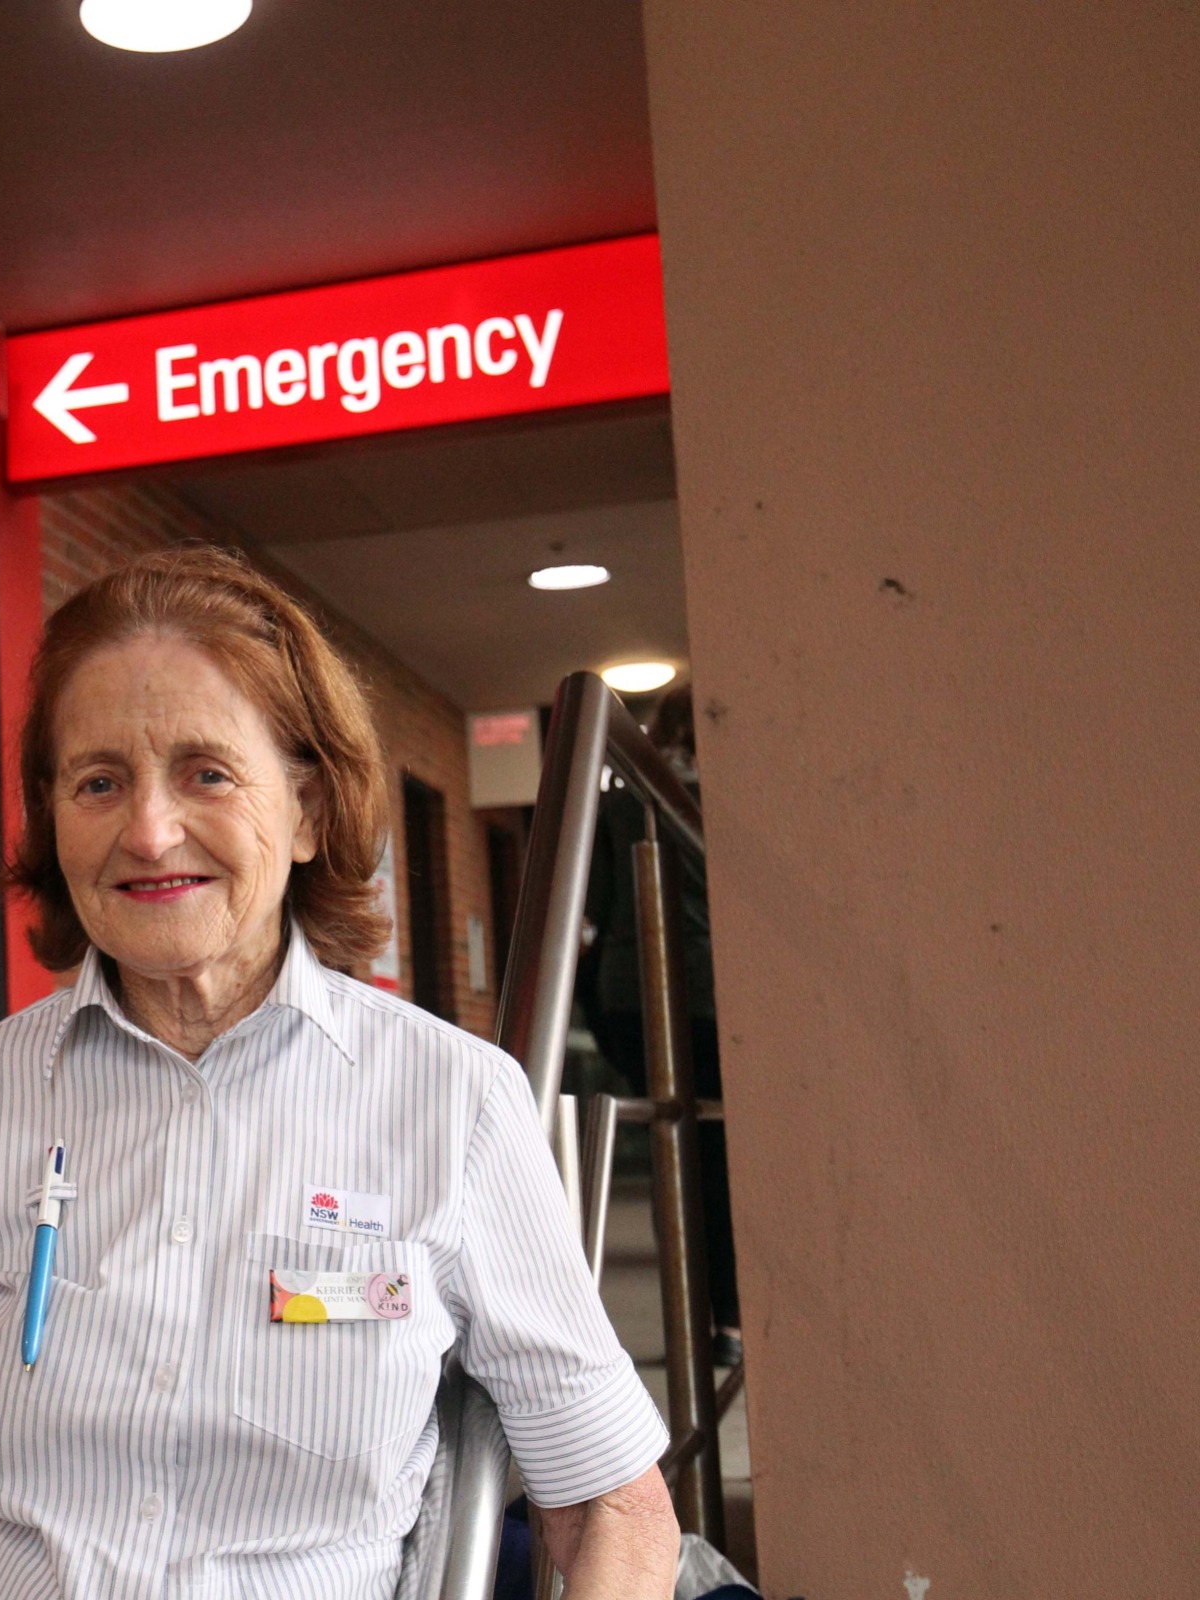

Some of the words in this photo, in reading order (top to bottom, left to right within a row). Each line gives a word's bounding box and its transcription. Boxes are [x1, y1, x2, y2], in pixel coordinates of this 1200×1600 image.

[154, 308, 564, 422] Emergency
[310, 1207, 339, 1220] NSW
[349, 1218, 384, 1233] Health
[315, 1286, 356, 1295] KERRIE
